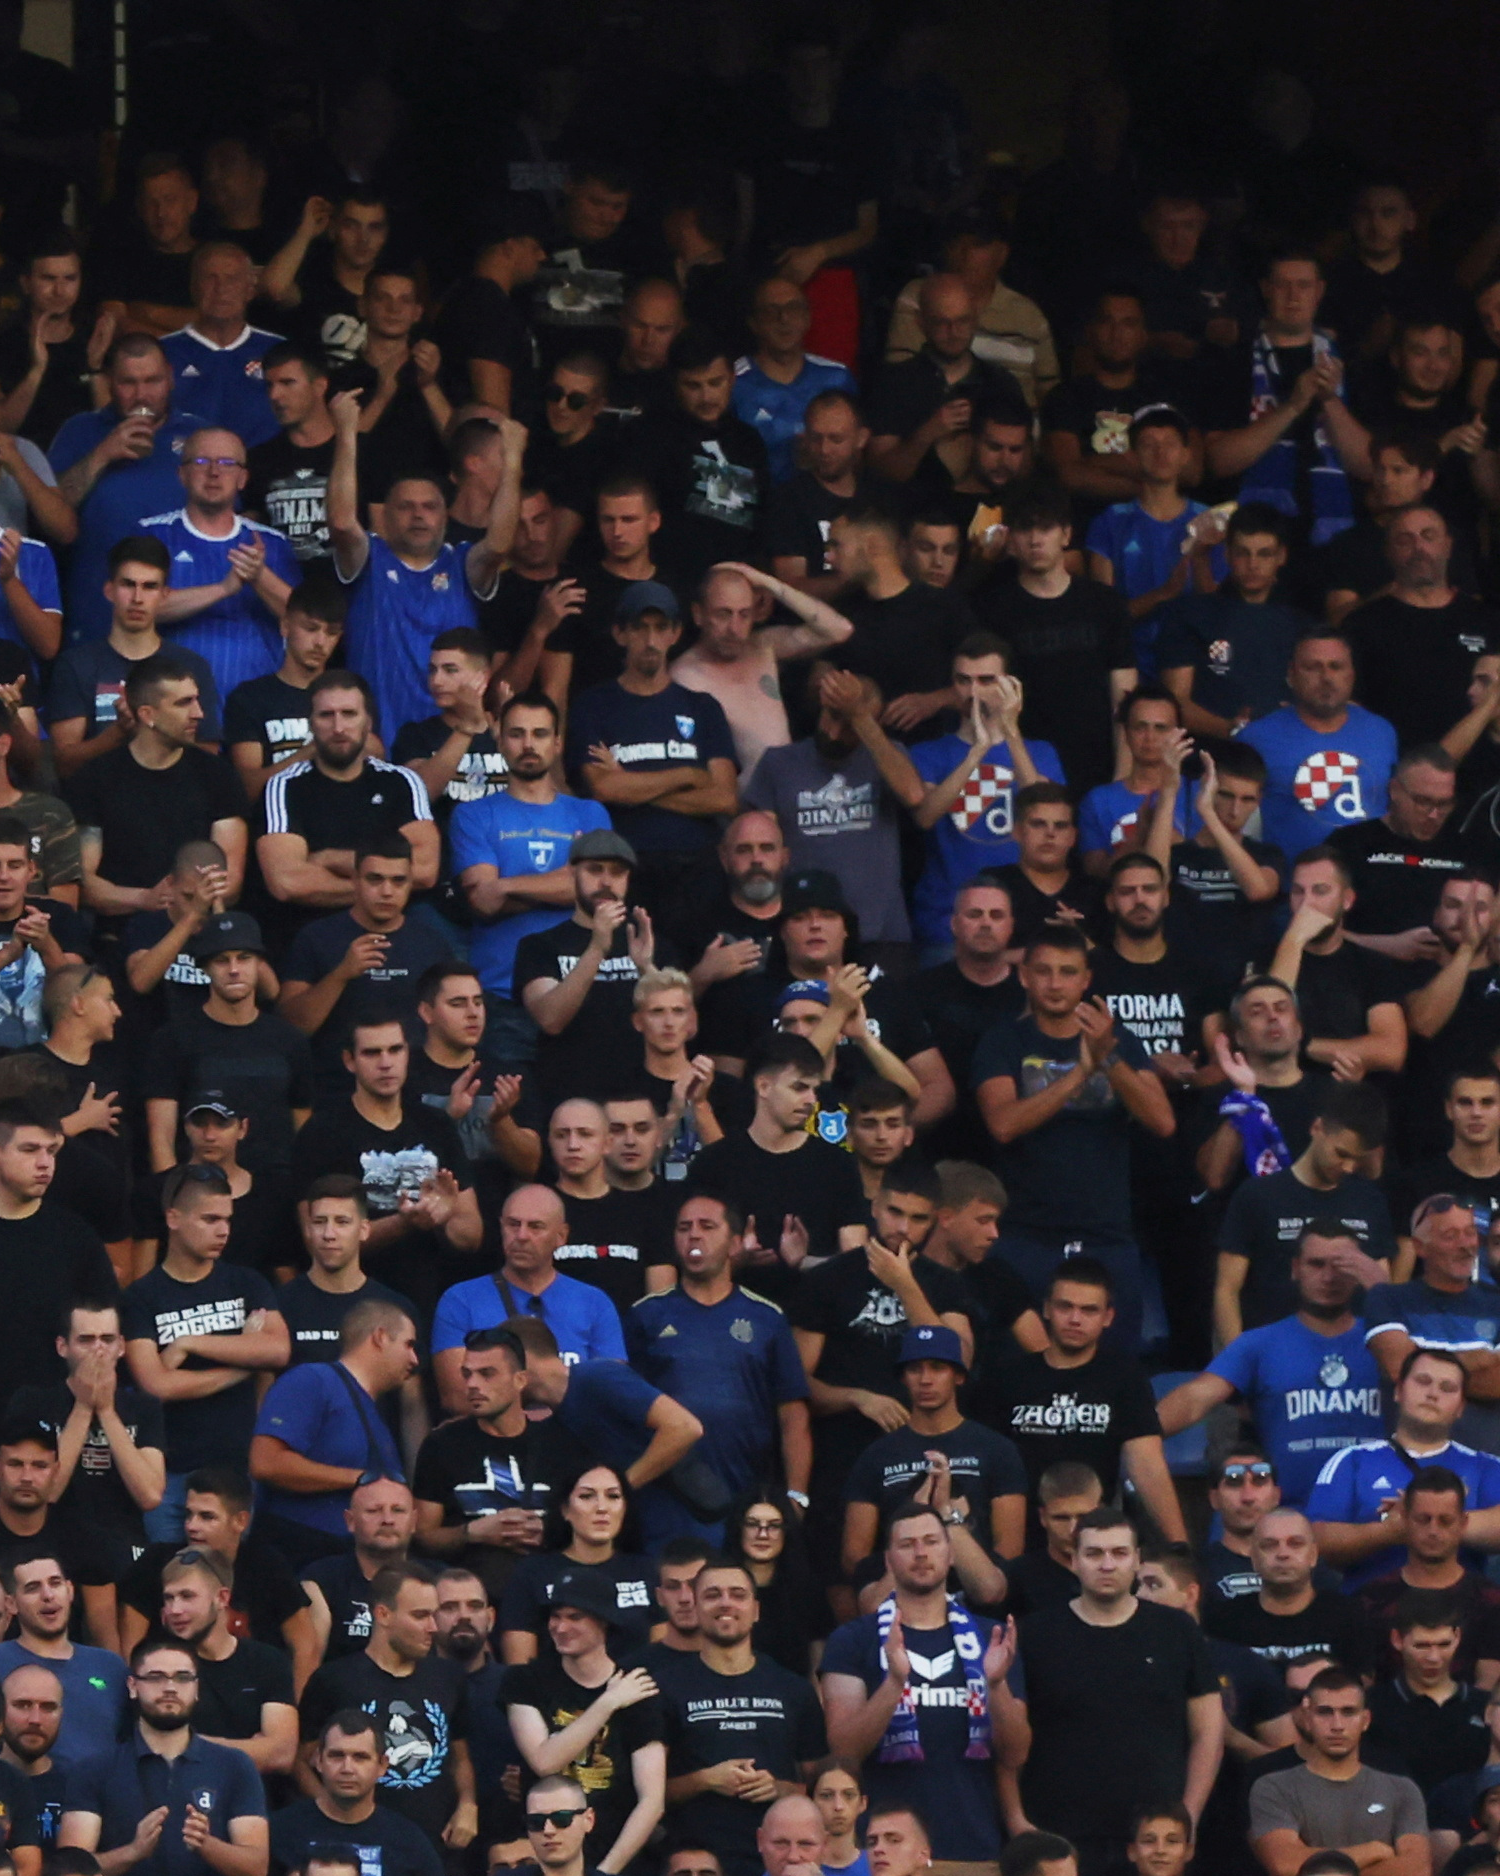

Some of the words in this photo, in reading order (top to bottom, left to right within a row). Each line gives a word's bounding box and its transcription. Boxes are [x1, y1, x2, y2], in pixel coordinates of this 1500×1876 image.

[1106, 993, 1185, 1020] FORMA
[181, 1303, 213, 1319] BLUE
[214, 1297, 244, 1313] BOYS
[1285, 1386, 1381, 1421] DINAMO
[347, 1625, 369, 1637] BAD
[687, 1699, 712, 1711] BAD
[715, 1698, 750, 1710] BLUE
[752, 1698, 784, 1710] BOYS
